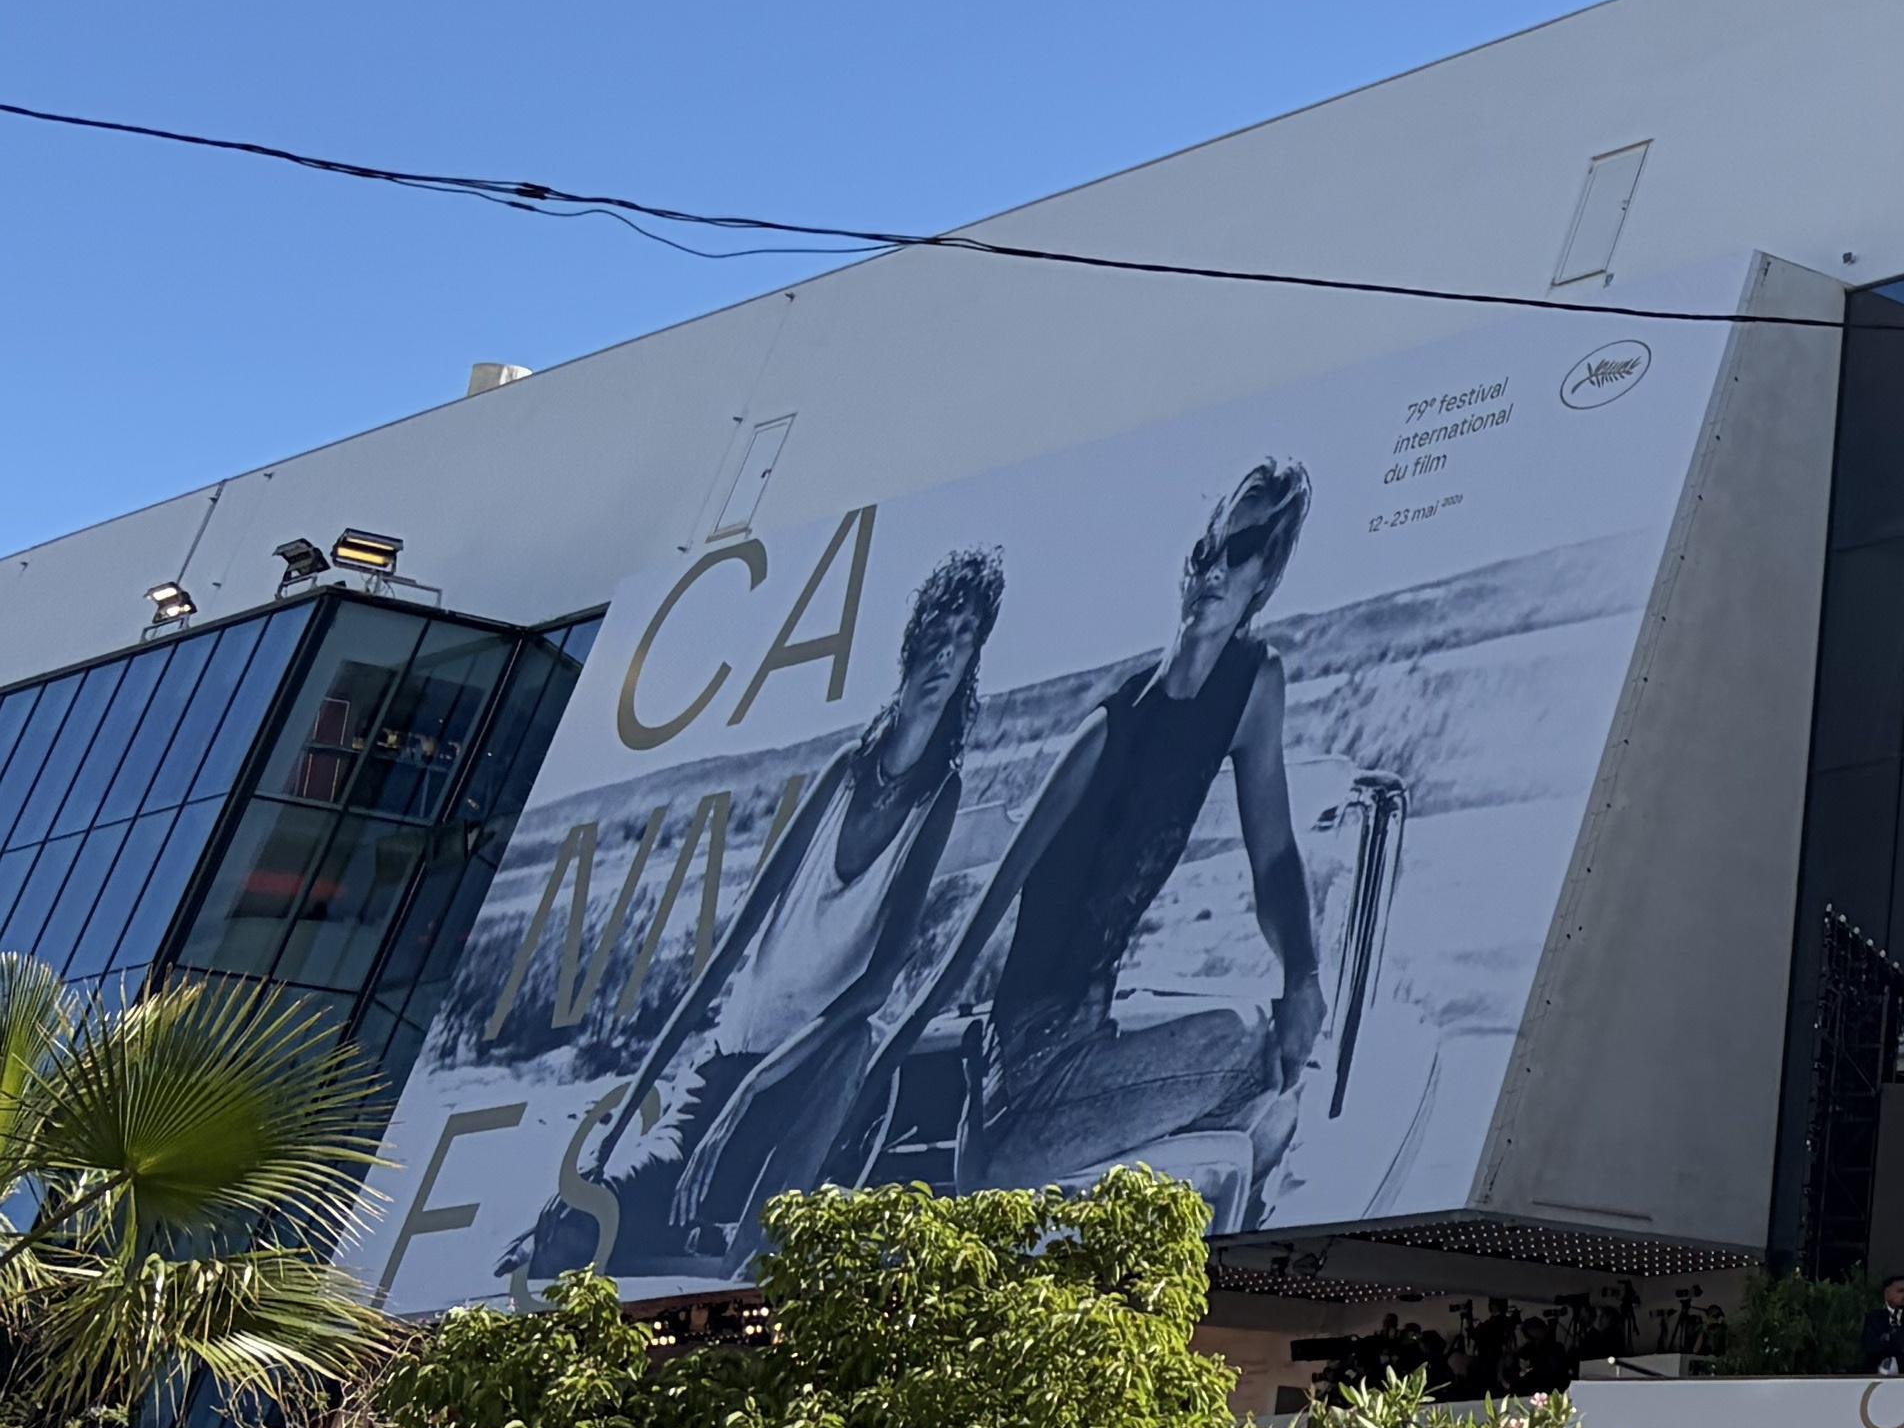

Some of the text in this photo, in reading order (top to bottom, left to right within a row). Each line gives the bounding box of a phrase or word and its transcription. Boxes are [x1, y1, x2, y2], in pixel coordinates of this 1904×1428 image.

[1437, 376, 1509, 415] festival
[1392, 403, 1515, 454] international
[1383, 452, 1448, 485] du film
[1410, 499, 1440, 522] mai
[616, 503, 878, 751] CA
